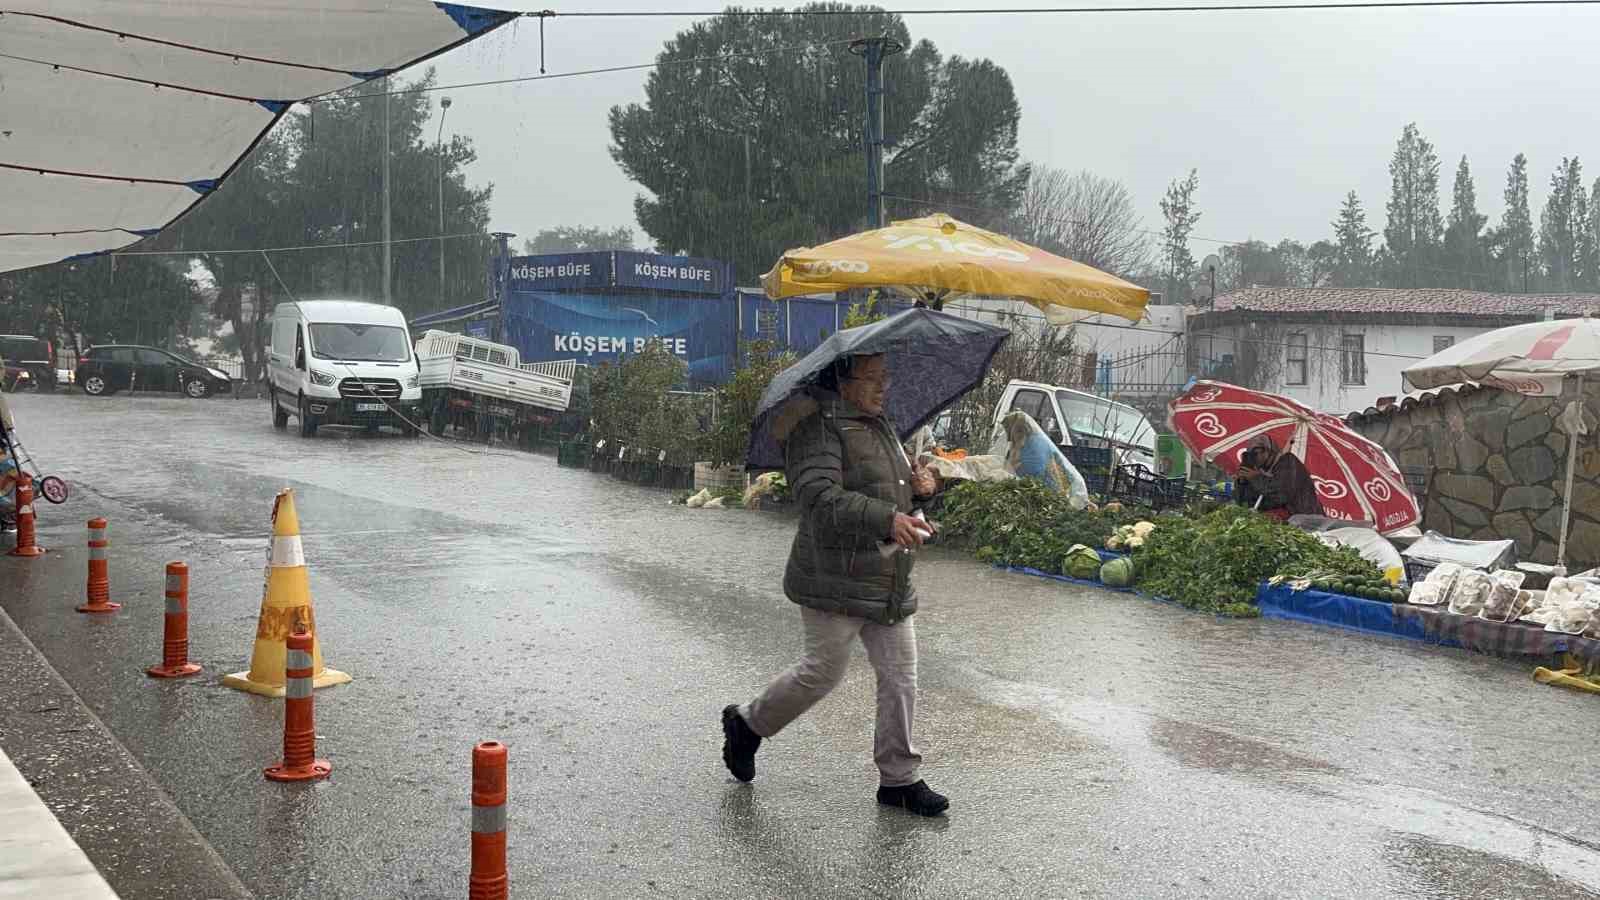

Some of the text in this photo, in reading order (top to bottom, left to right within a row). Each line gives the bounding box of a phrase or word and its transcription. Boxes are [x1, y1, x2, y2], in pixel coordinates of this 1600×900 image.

[511, 262, 591, 281] KÖŞEM BÜFE
[634, 261, 711, 281] KÖŞEM BÜFE
[554, 331, 687, 356] KÖŞEM BFE
